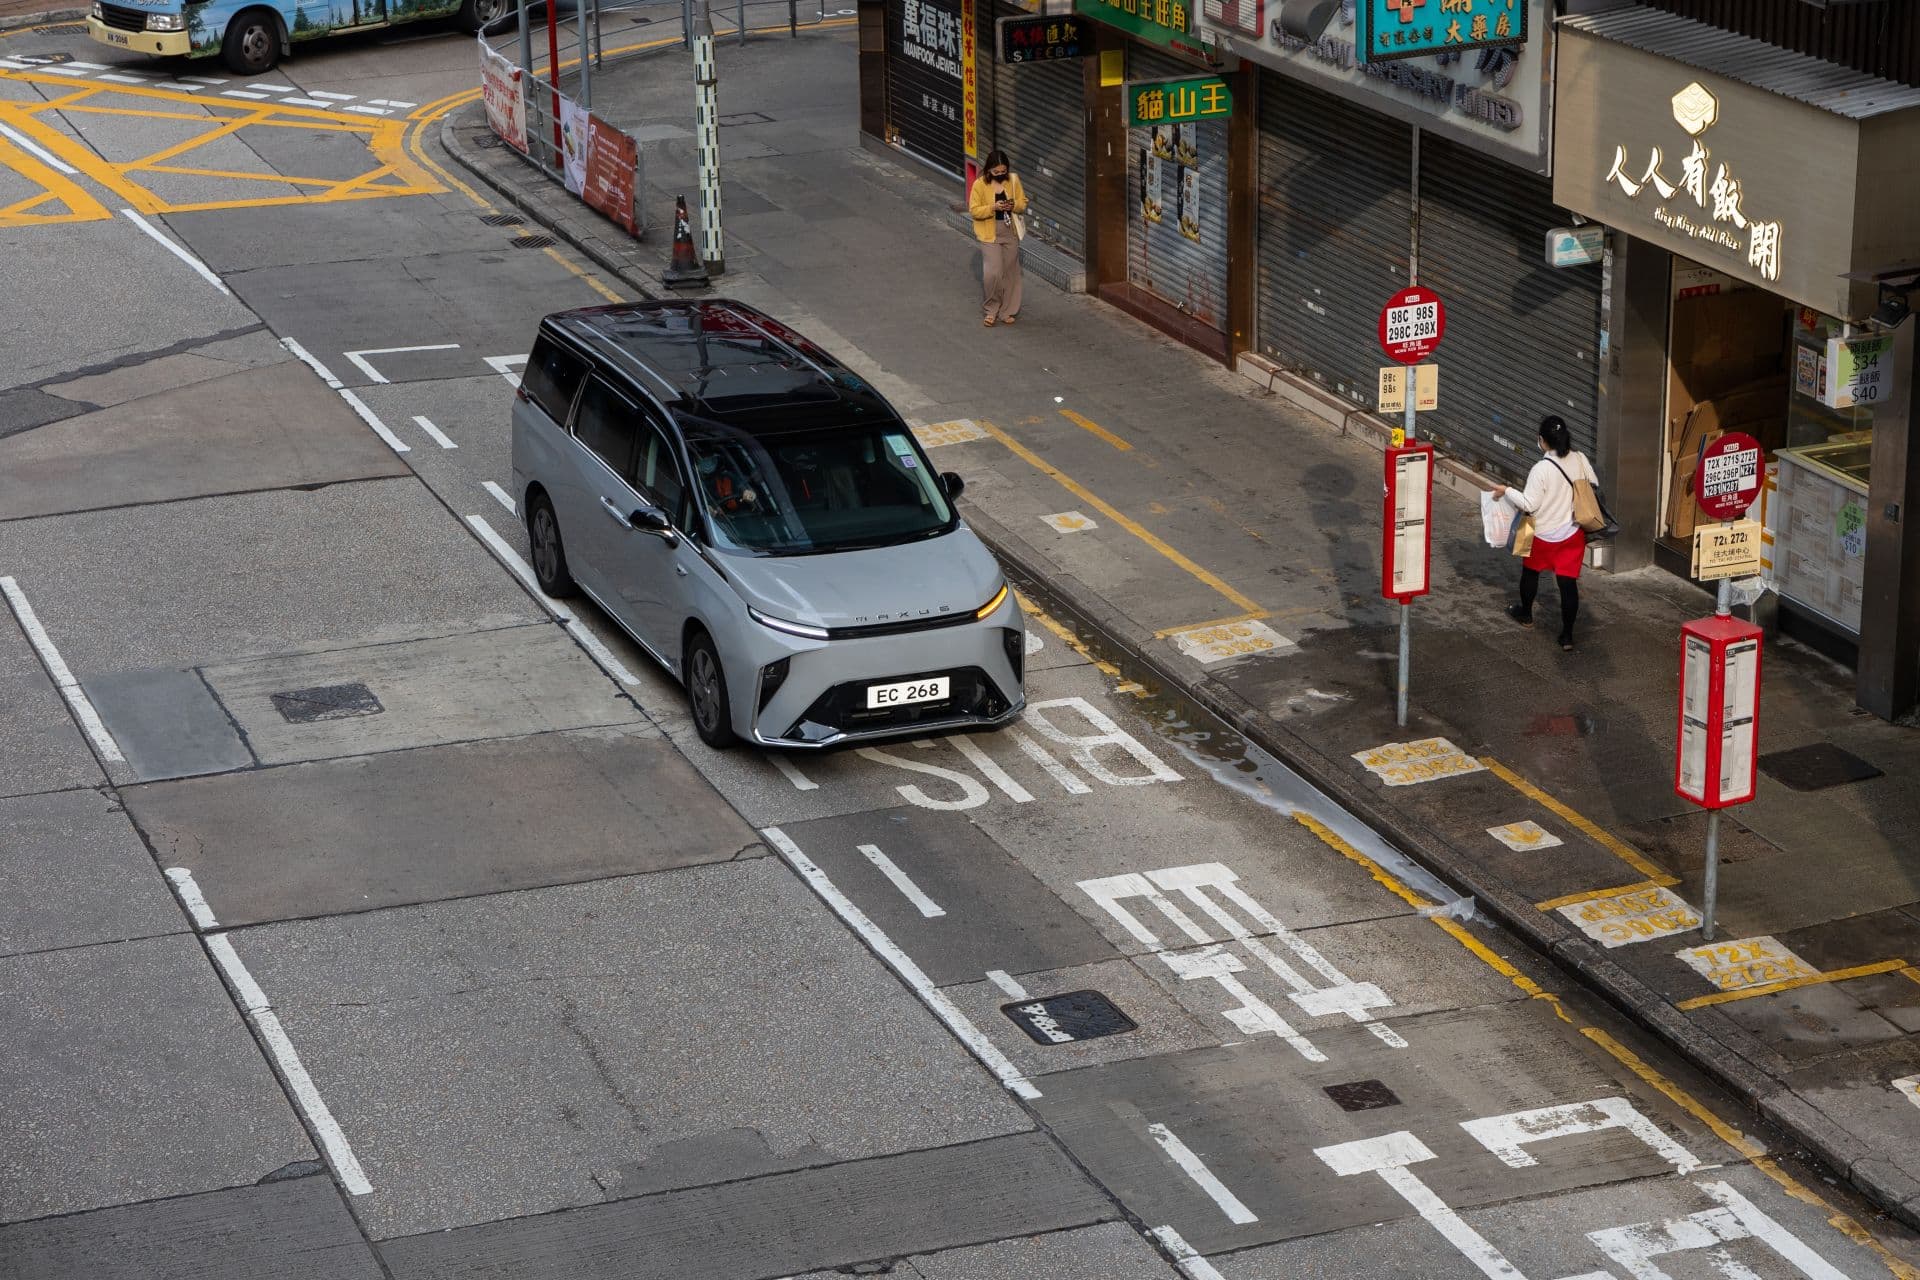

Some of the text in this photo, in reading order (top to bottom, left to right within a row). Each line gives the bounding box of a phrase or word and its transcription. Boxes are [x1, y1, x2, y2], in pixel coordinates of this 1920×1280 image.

[1444, 12, 1512, 44] 大藥房
[903, 40, 936, 67] MANFOOK
[1136, 82, 1229, 121] 貓山王
[1605, 139, 1782, 282] 人人有飯開
[1391, 305, 1433, 324] 98C 98S
[1389, 320, 1436, 341] 298C 298X
[1853, 353, 1878, 371] $34
[1851, 385, 1877, 404] $40
[1707, 450, 1756, 470] 72X 271S 272X
[1705, 471, 1721, 484] 296C
[1723, 467, 1739, 480] 296P
[854, 604, 951, 623] MAXUS
[876, 682, 939, 704] EC 268
[1693, 940, 1778, 967] 72X
[1707, 956, 1811, 988] 272X
